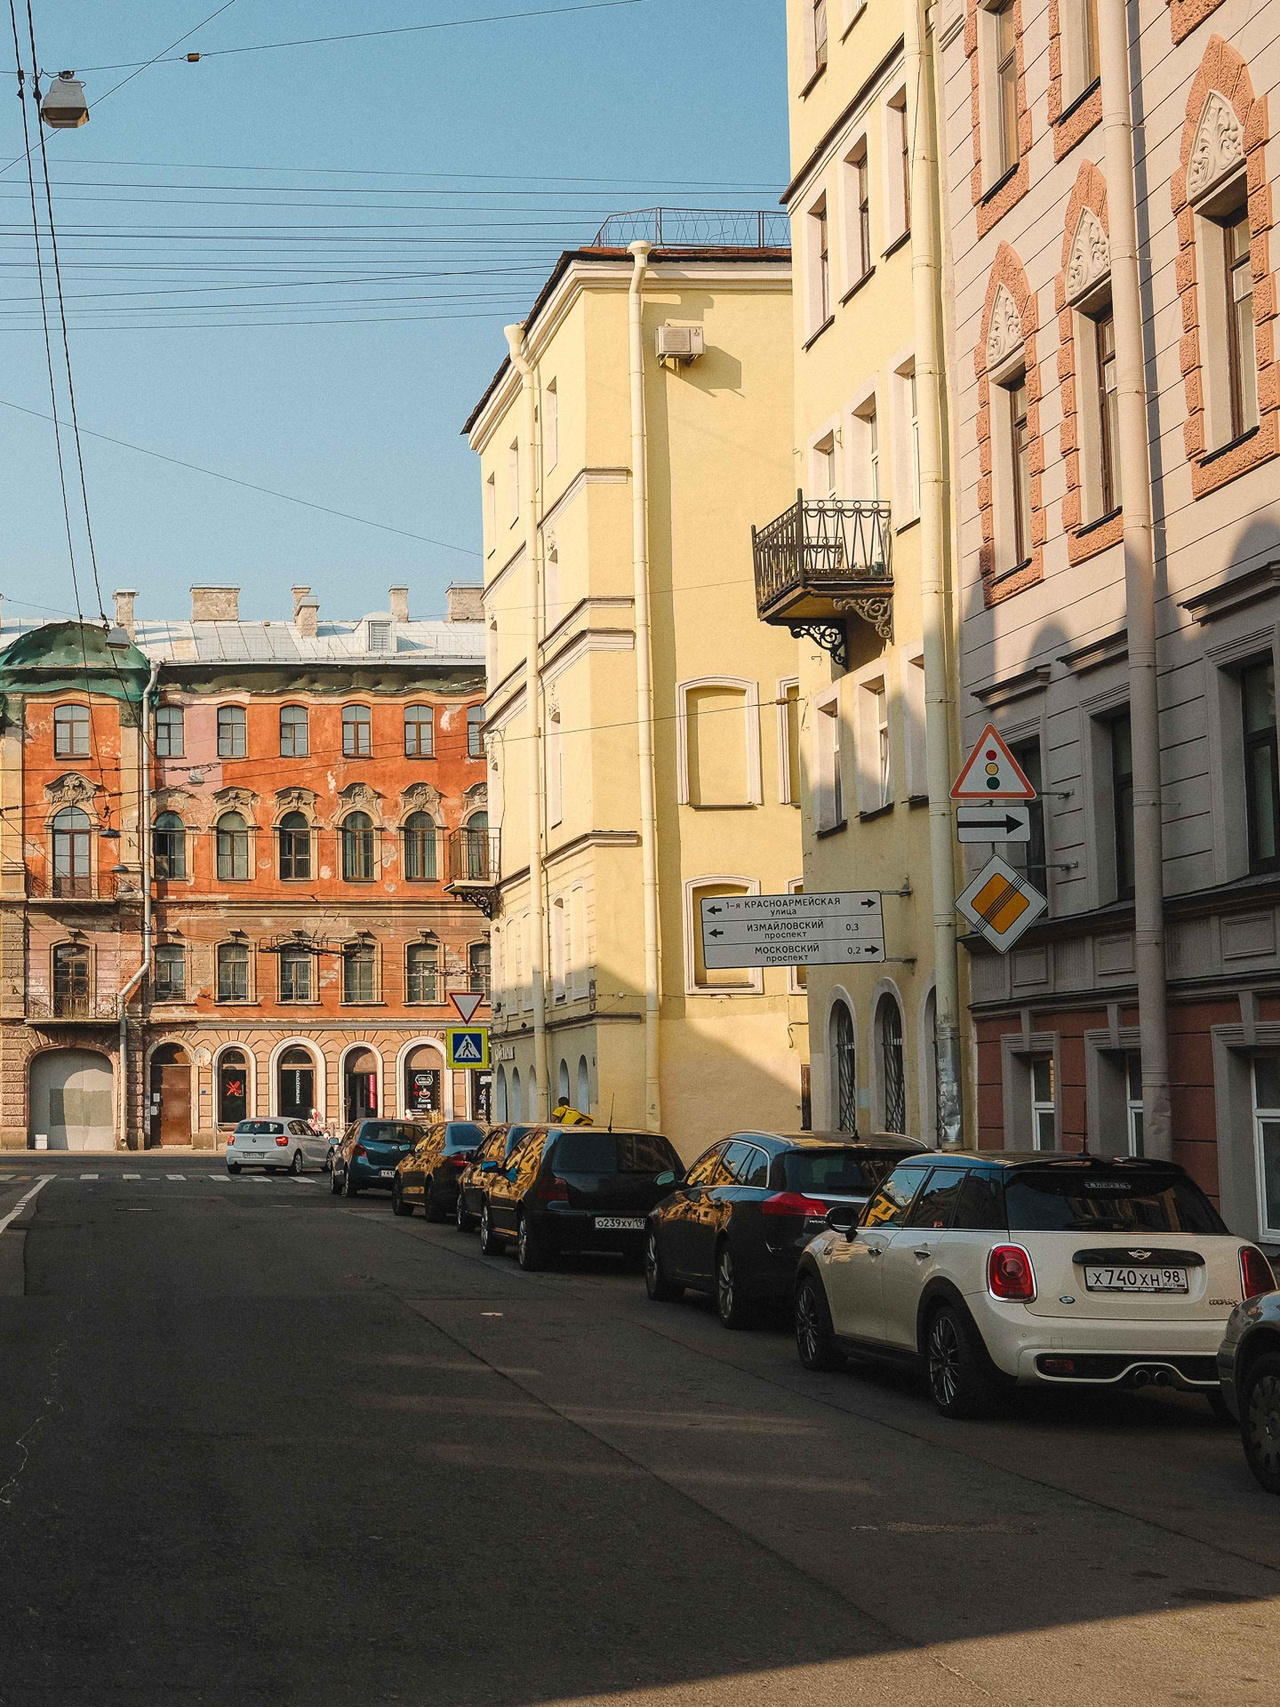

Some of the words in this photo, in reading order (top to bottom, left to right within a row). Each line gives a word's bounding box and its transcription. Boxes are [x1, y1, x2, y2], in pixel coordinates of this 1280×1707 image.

[744, 896, 841, 908] КРАСНОАРМЕЙСКАЯ
[770, 909, 797, 917] улица
[746, 919, 824, 932] ИЗМАЙЛОВСКИЙ
[764, 931, 807, 940] проспект
[754, 942, 820, 955] МОСКОВСКИЙ
[766, 954, 809, 963] проспект
[1163, 1270, 1180, 1283] 98
